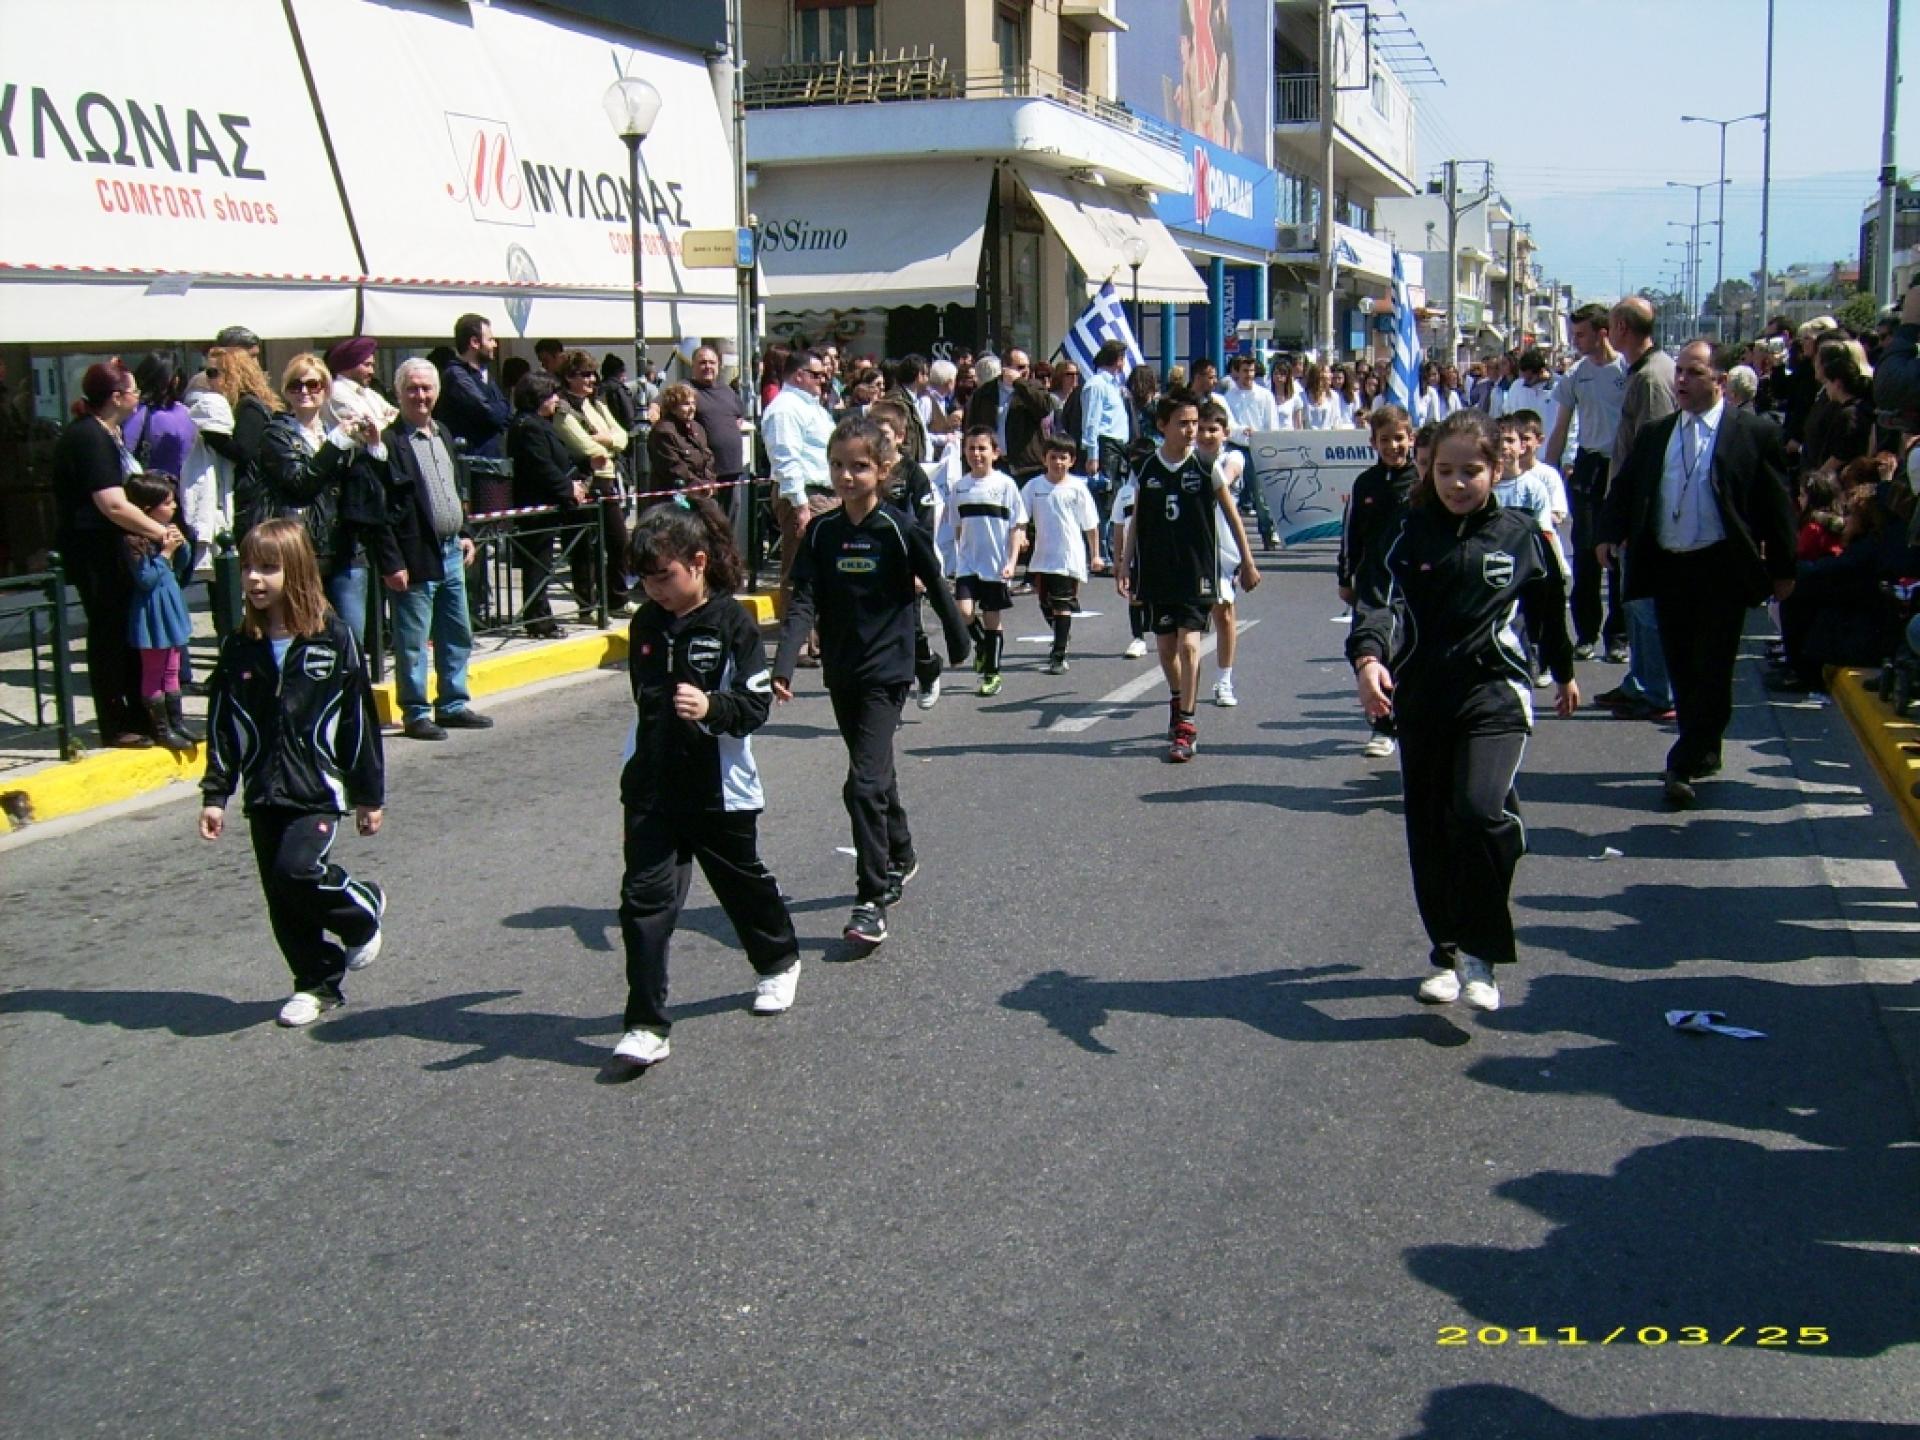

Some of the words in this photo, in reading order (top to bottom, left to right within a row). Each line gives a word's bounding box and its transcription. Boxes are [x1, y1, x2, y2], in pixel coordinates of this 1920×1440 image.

[96, 178, 207, 219] COMFORT
[213, 192, 279, 225] shoes
[521, 160, 692, 227] ΜΥΛΩΝΑΣ
[1165, 494, 1180, 521] 5
